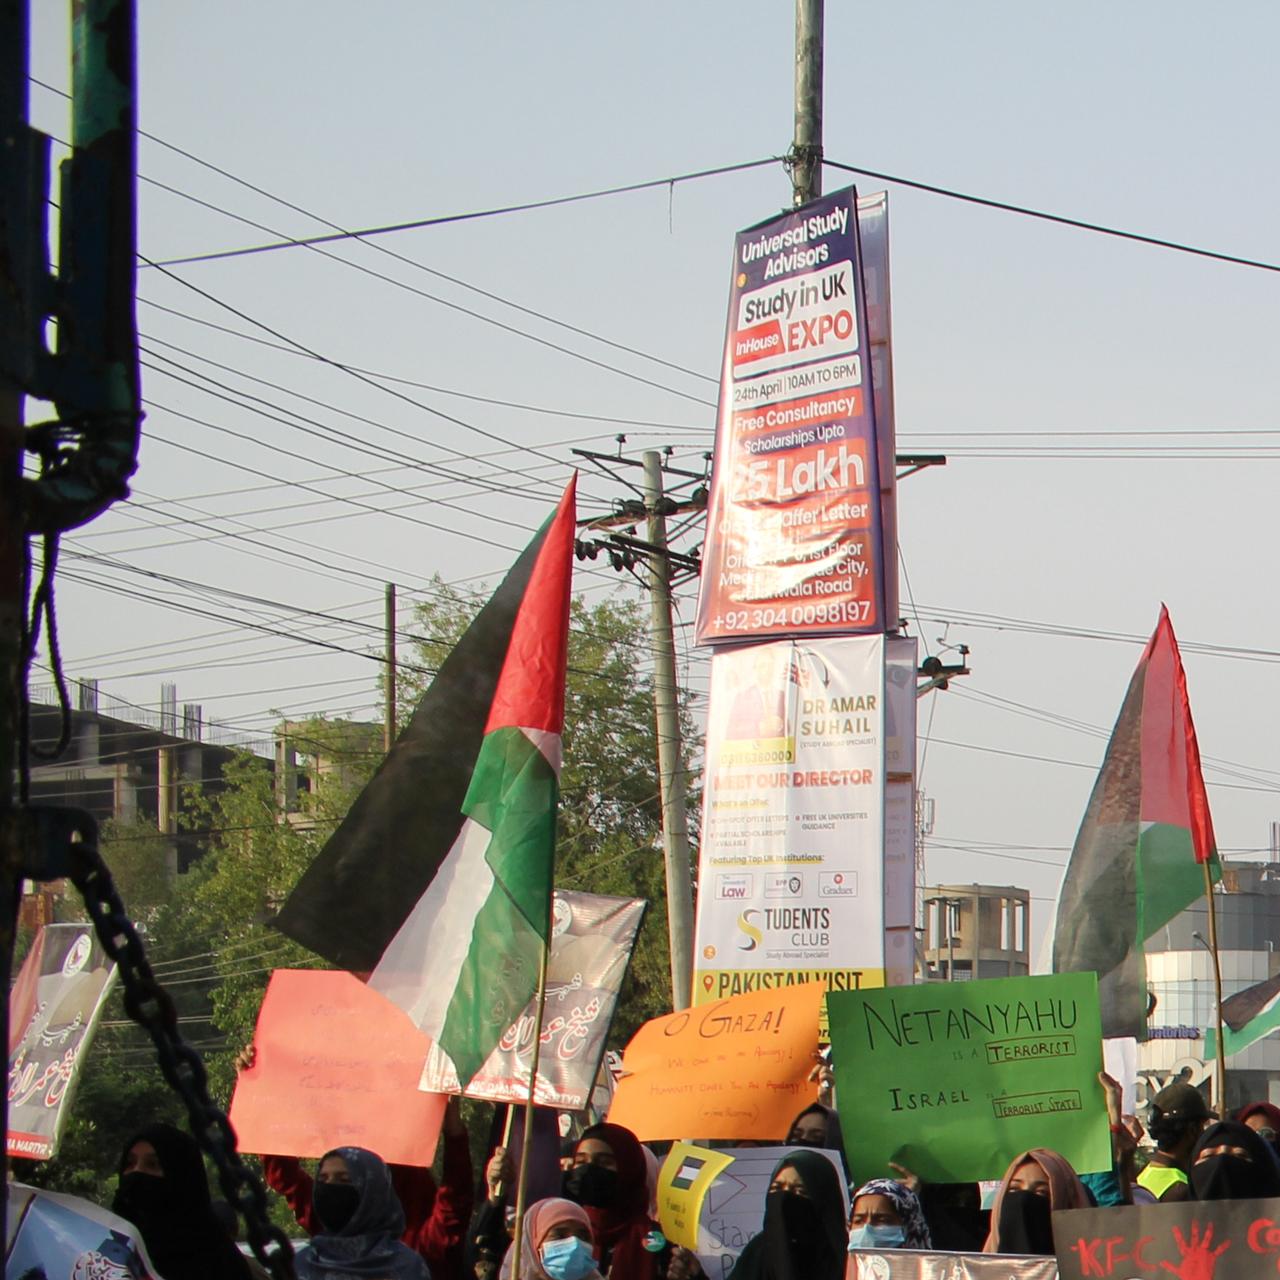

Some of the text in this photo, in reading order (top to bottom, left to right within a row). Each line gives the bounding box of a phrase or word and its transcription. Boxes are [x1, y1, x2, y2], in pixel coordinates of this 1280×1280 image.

[742, 206, 848, 264] Universal Study
[764, 243, 829, 280] Advisors
[745, 271, 847, 323] Study in UK
[736, 309, 853, 356] InHouse EXPO
[760, 377, 783, 400] April
[817, 369, 831, 382] TO
[833, 363, 857, 380] 6PM
[735, 396, 855, 433] Free Consultancy
[744, 424, 845, 454] Scholarships Upto
[777, 446, 864, 496] Lakh
[711, 600, 871, 631] +92 304 0098197
[802, 695, 877, 715] DR AMAR
[801, 717, 871, 737] SUHAIL
[793, 769, 873, 788] DIRECTOR
[791, 932, 830, 947] CLUB
[699, 1000, 785, 1038] GAZA!
[863, 999, 1078, 1051] NETANYAHU
[988, 1042, 1071, 1061] TERRORIST
[889, 1088, 969, 1112] ISRAEL
[1071, 1234, 1158, 1278] KFC
